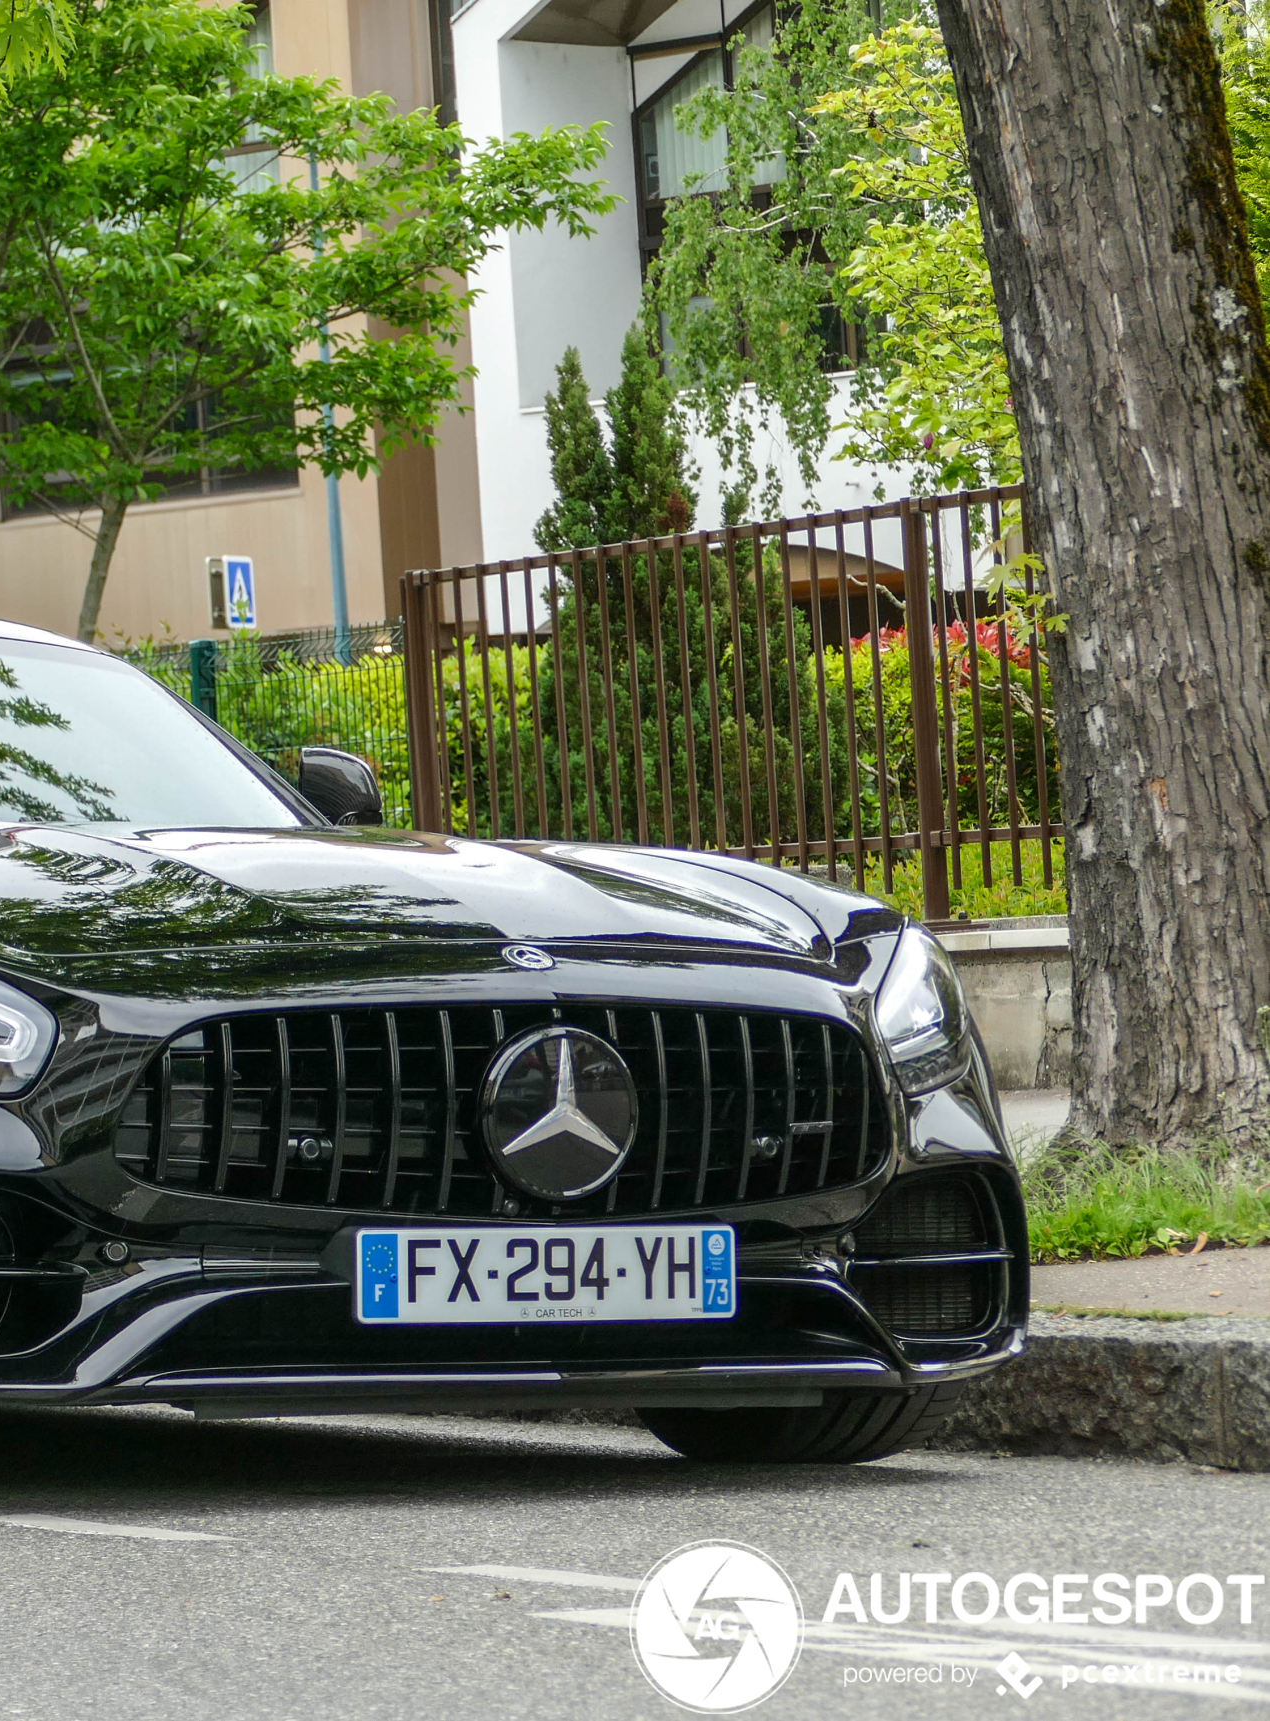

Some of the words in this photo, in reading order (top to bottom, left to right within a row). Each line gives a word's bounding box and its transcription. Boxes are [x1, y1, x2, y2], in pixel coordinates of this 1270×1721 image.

[407, 1236, 697, 1303] FX-294-YH
[374, 1284, 386, 1302] F
[705, 1279, 729, 1305] 73
[535, 1308, 556, 1318] CAR
[557, 1308, 583, 1318] TECH
